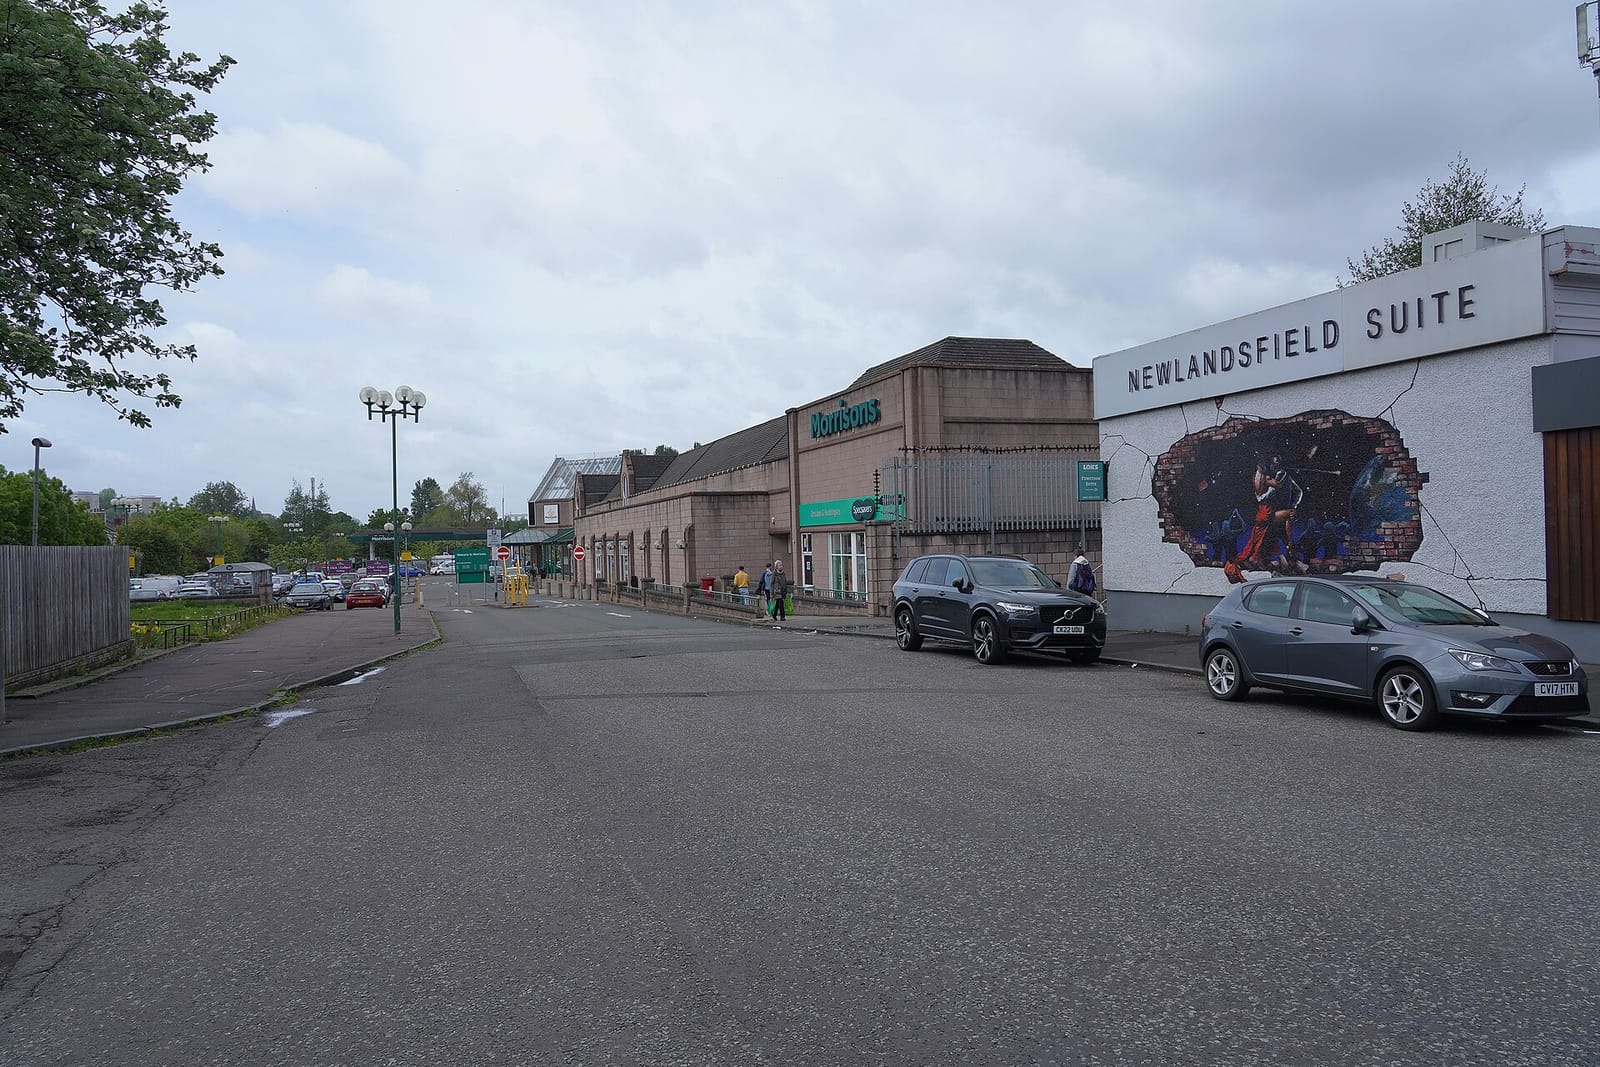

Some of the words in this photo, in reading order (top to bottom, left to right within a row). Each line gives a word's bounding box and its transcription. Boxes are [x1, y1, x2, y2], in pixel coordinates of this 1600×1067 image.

[1128, 320, 1340, 393] NEWLANDSFIELD
[1366, 284, 1475, 339] SUITE
[811, 398, 880, 439] Morrisons
[1540, 683, 1559, 694] CV17
[1560, 683, 1575, 694] HTN
